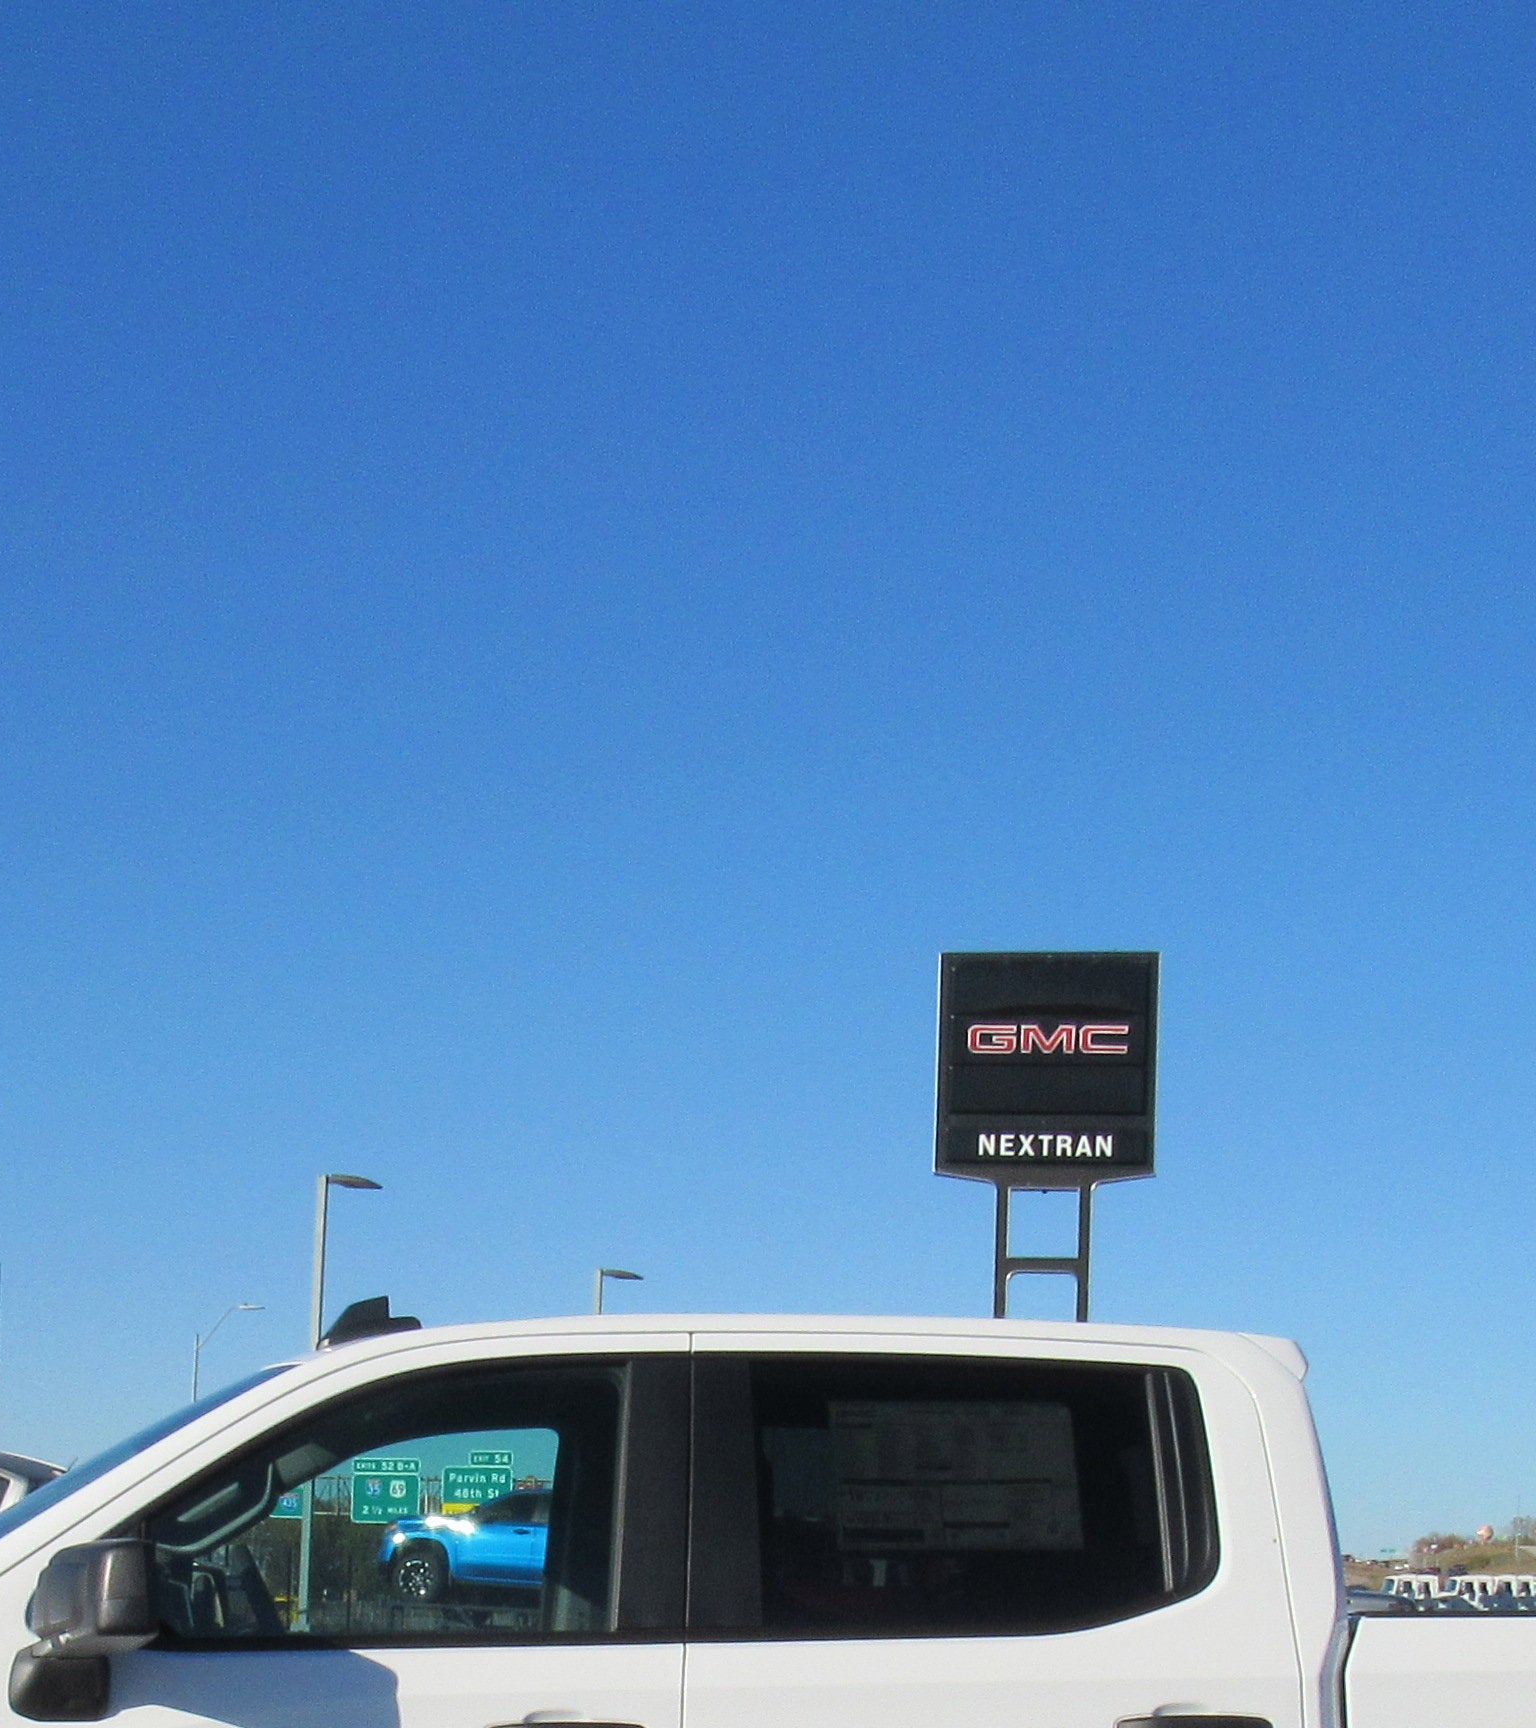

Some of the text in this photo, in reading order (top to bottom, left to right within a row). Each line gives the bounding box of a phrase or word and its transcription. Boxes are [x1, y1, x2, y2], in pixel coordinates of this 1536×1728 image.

[967, 1024, 1130, 1054] GMC
[978, 1133, 1113, 1157] NEXTRAN
[494, 1454, 510, 1464] 54
[449, 1473, 507, 1483] Parvin Rd
[391, 1483, 405, 1495] 69
[487, 1488, 500, 1499] St
